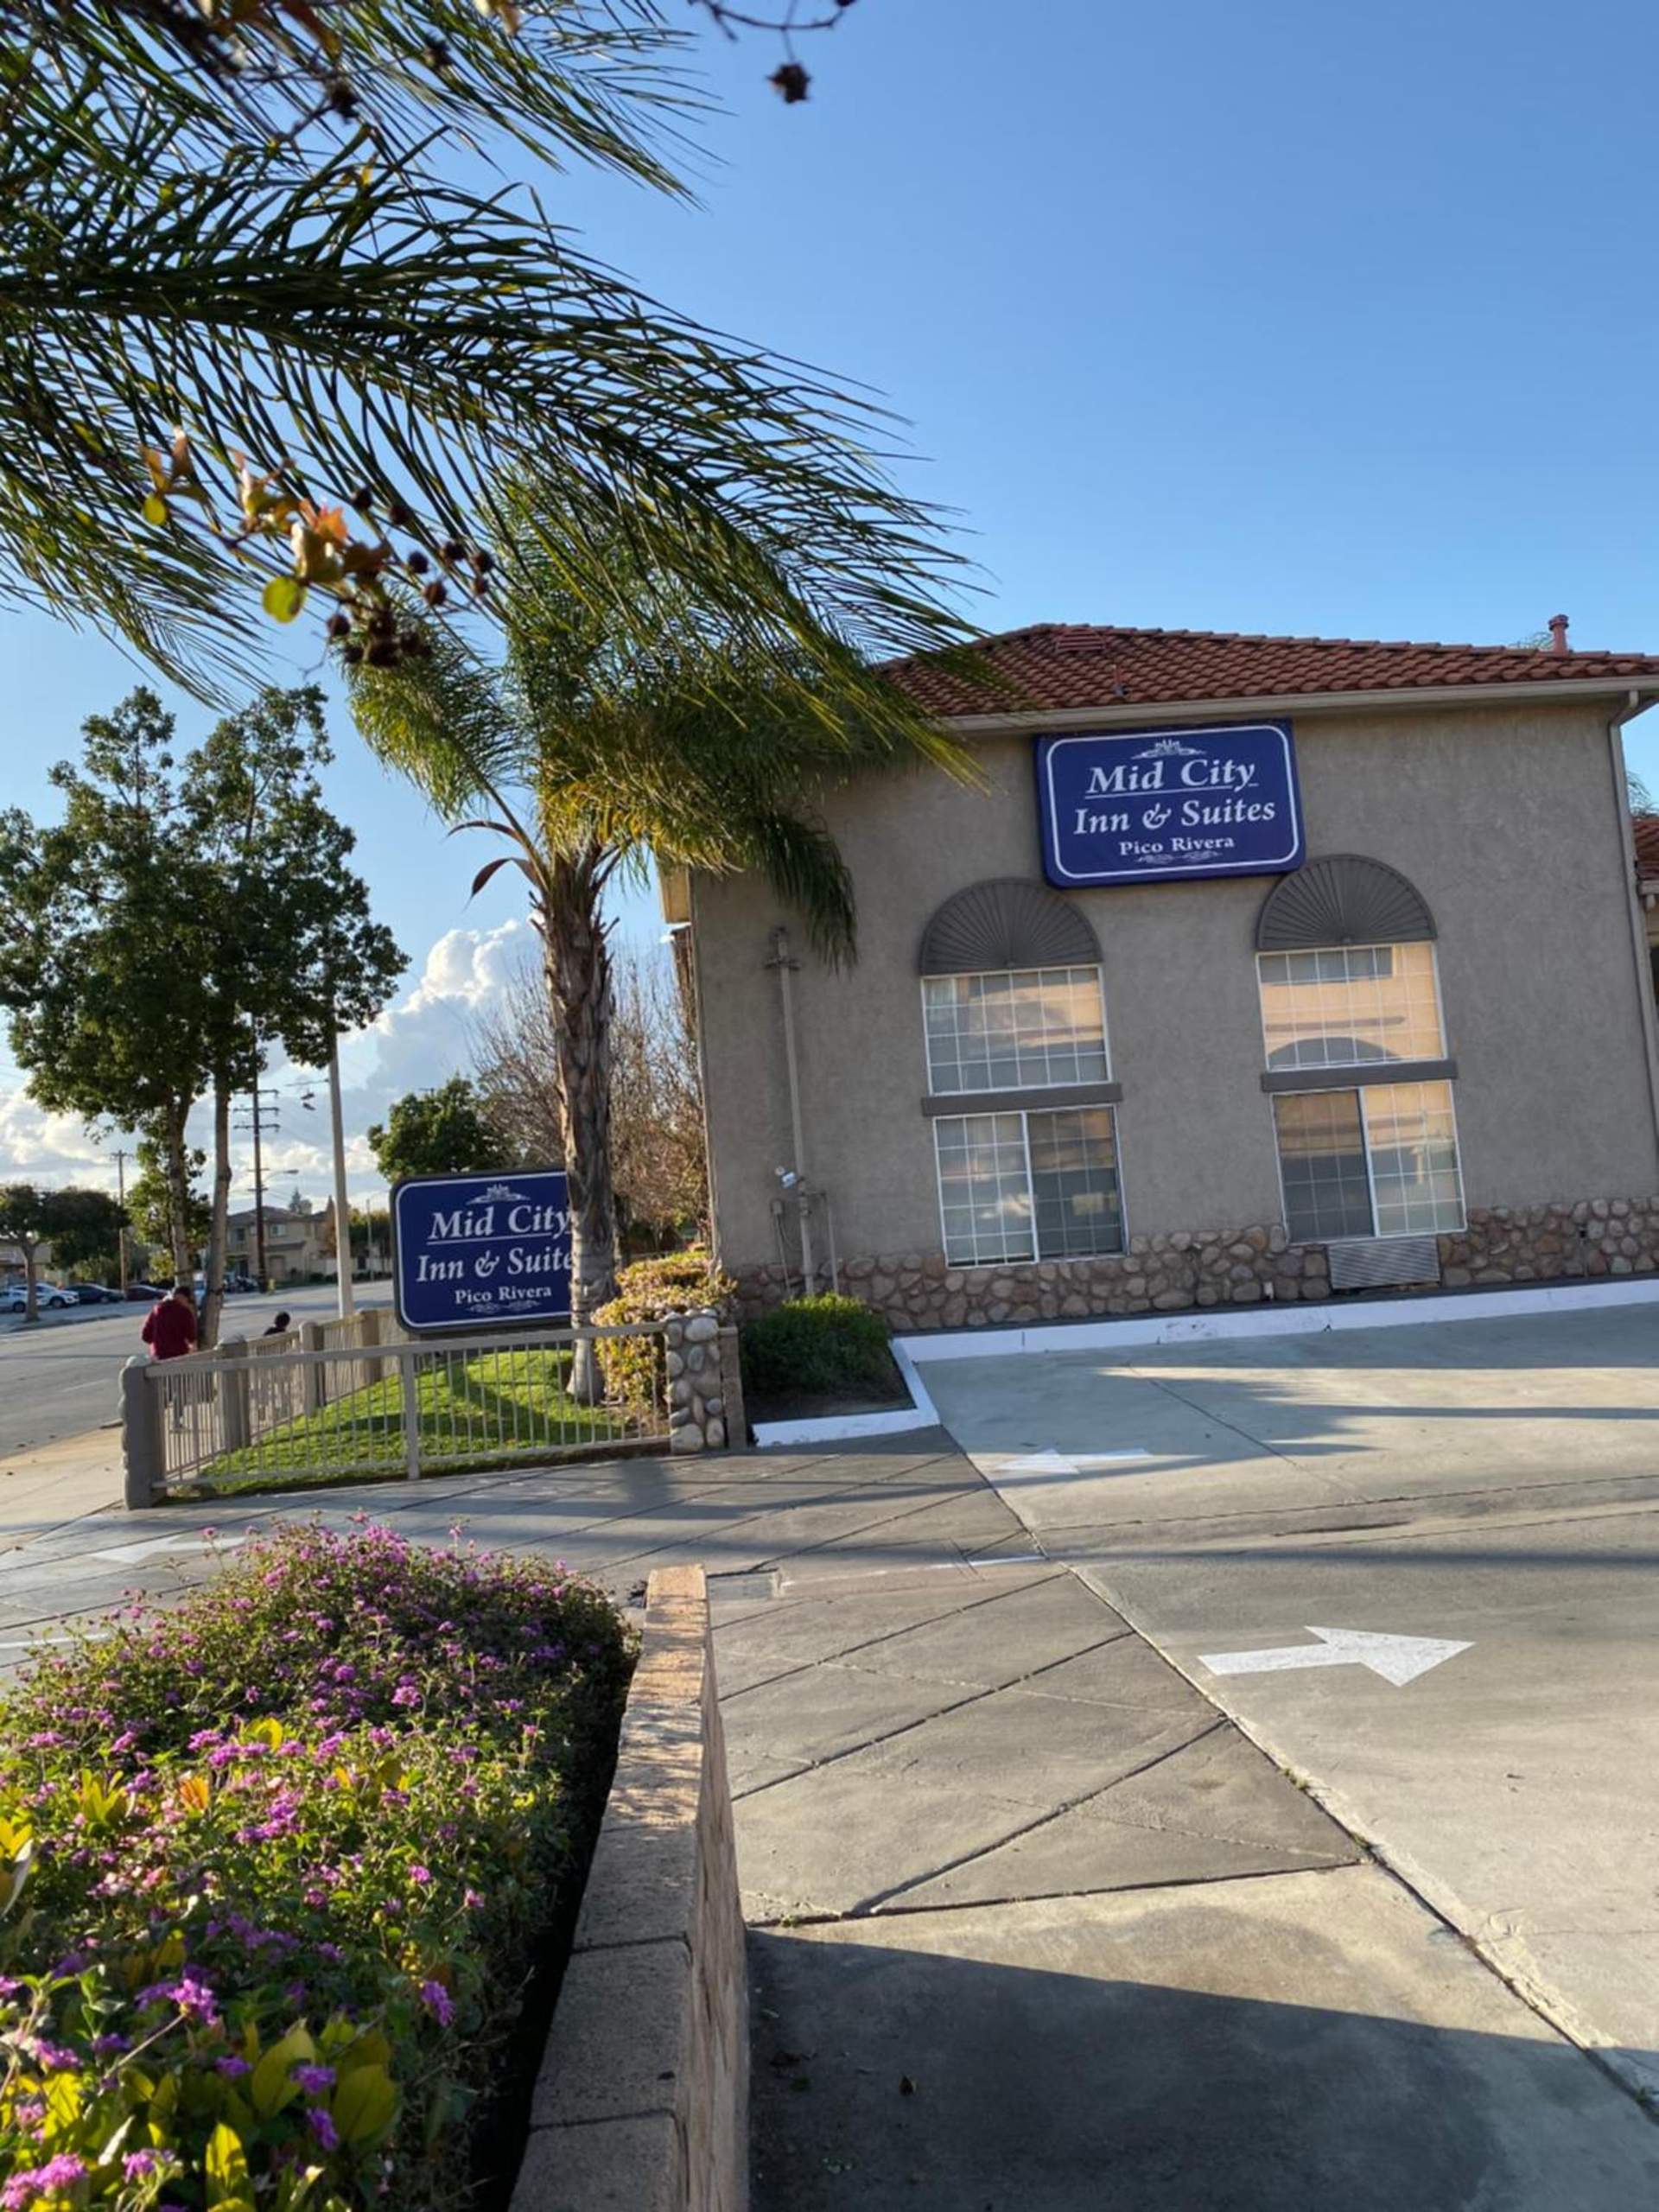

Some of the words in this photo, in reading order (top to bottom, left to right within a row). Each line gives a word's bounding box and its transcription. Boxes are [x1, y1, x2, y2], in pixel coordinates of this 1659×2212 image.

[1086, 761, 1164, 792] Mid
[1181, 759, 1255, 792] City
[1073, 808, 1130, 835] Inn
[1142, 804, 1171, 830] &
[1181, 800, 1275, 827] Suites
[1120, 842, 1164, 856] Pico
[1170, 836, 1236, 852] Rivera
[429, 1206, 493, 1240] Mid
[508, 1205, 570, 1239] City
[416, 1255, 465, 1282] Inn
[474, 1250, 500, 1278] &
[507, 1247, 573, 1275] Suite
[454, 1289, 492, 1304] Pico
[499, 1286, 552, 1300] Rivera
